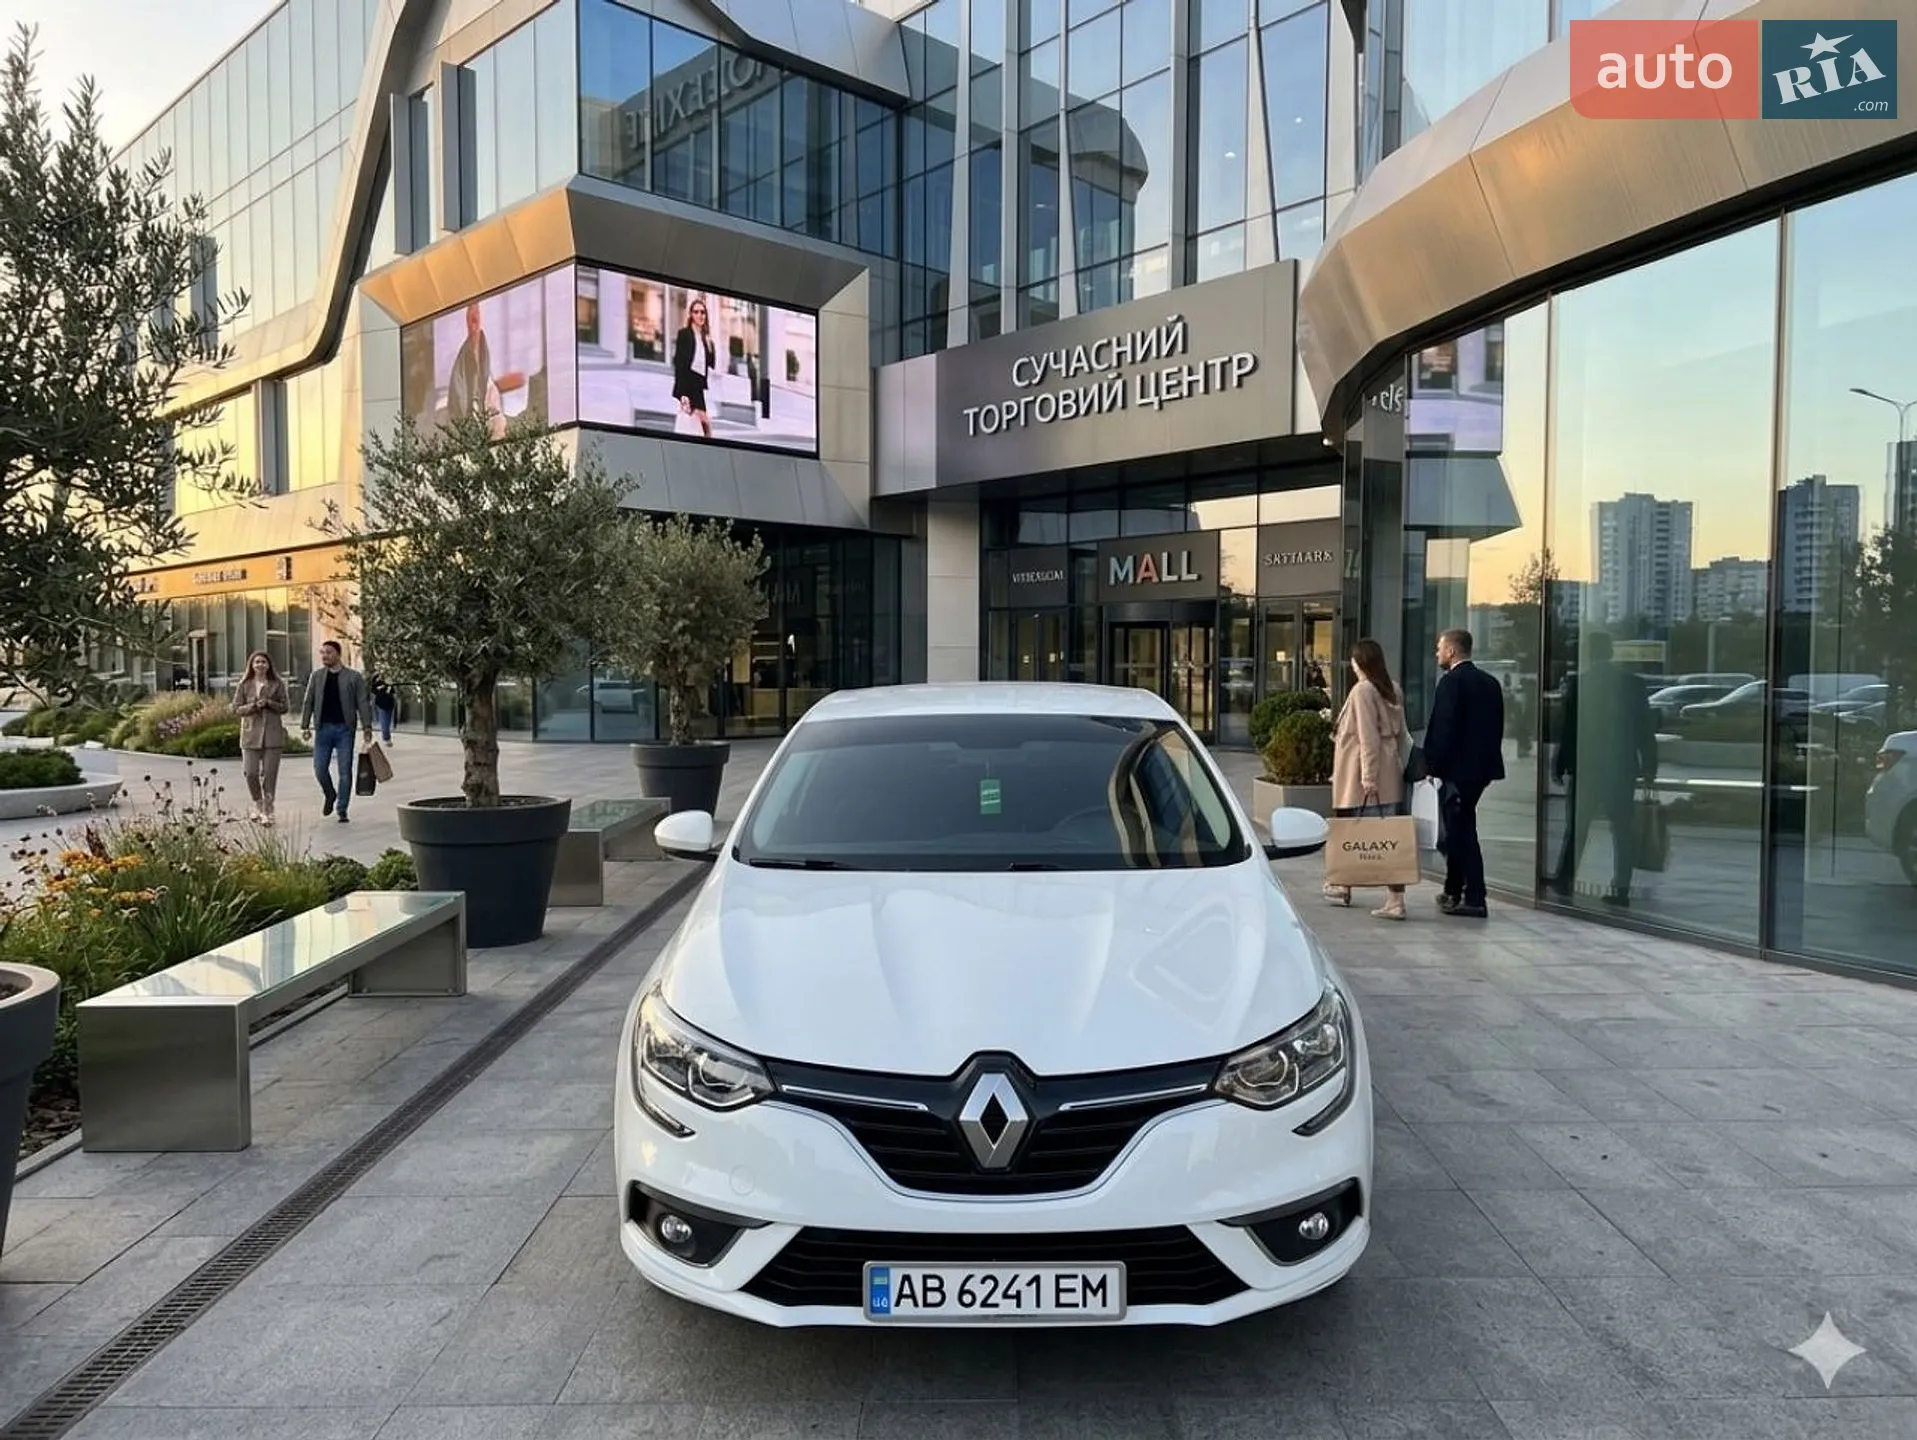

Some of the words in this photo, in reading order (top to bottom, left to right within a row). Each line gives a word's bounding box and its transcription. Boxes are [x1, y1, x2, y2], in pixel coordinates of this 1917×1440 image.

[1012, 313, 1188, 388] СУЧАСНИЙ
[963, 372, 1125, 437] ТОРГОВИЙ
[1135, 351, 1257, 411] ЦЕНТР
[1108, 550, 1199, 586] MALL
[1341, 840, 1399, 852] GALAXY
[894, 1273, 947, 1308] AB
[957, 1273, 1042, 1308] 6241
[1054, 1273, 1108, 1308] EM
